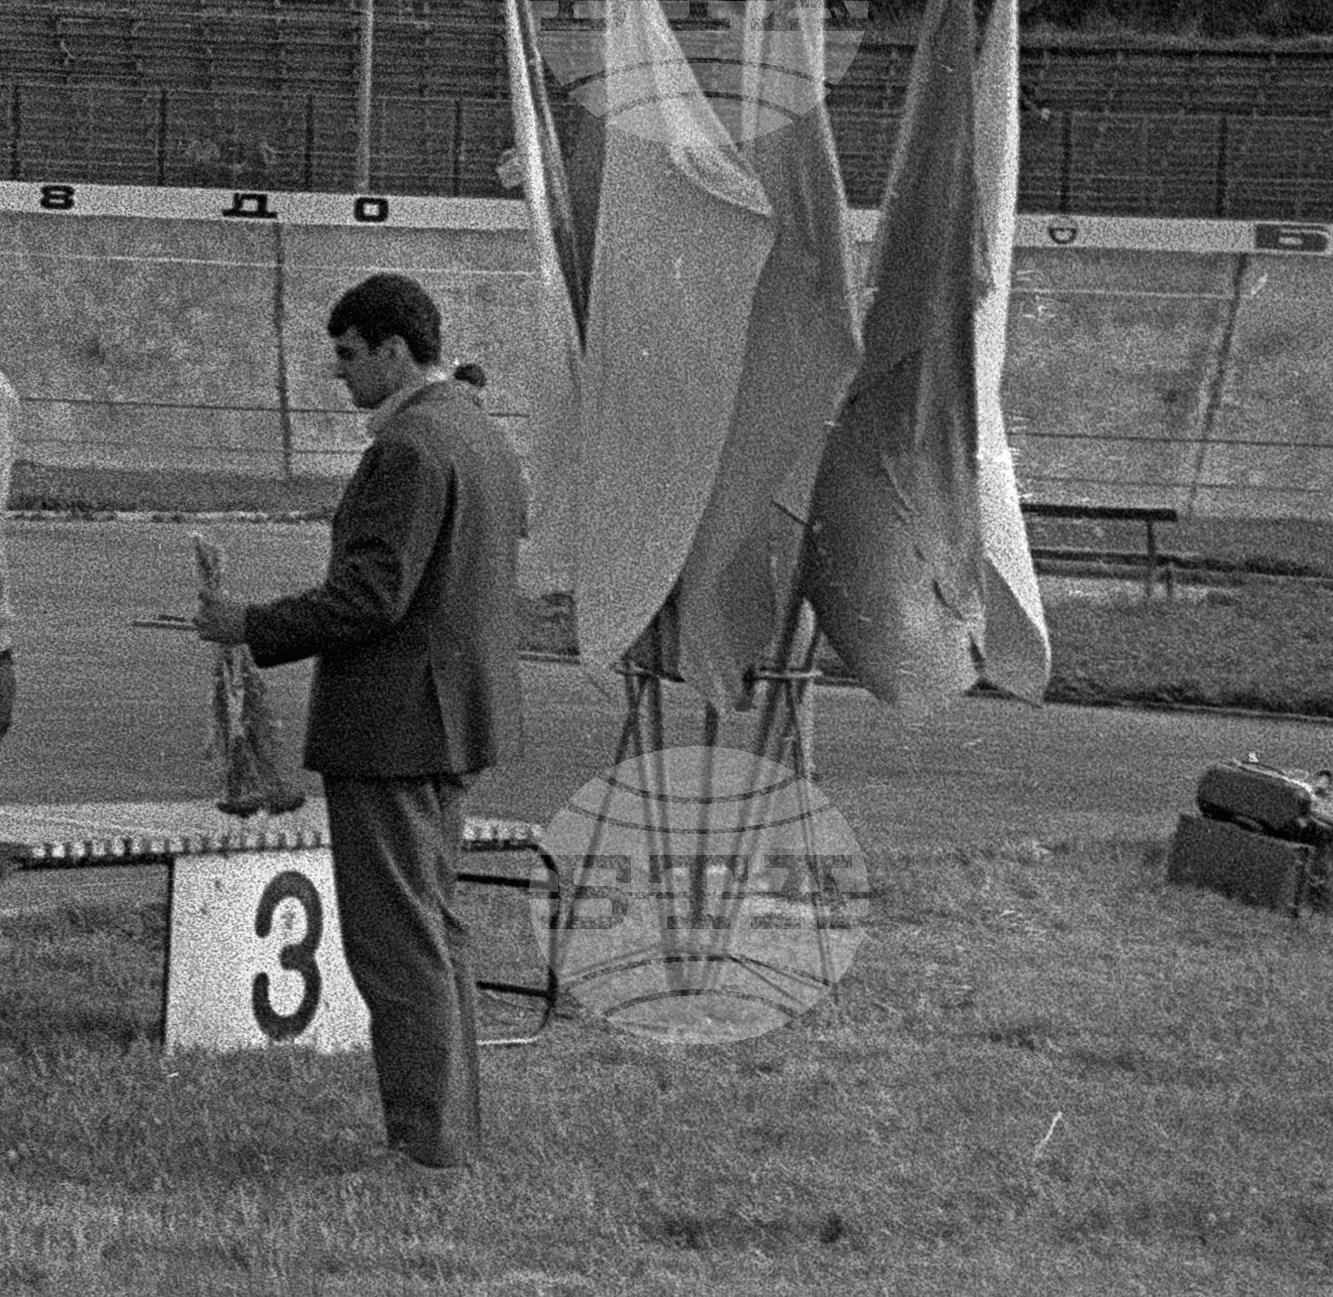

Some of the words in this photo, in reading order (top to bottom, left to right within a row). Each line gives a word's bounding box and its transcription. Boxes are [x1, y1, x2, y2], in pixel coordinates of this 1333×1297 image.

[40, 184, 76, 211] 8
[222, 192, 390, 224] ДО
[252, 870, 324, 1042] 3
